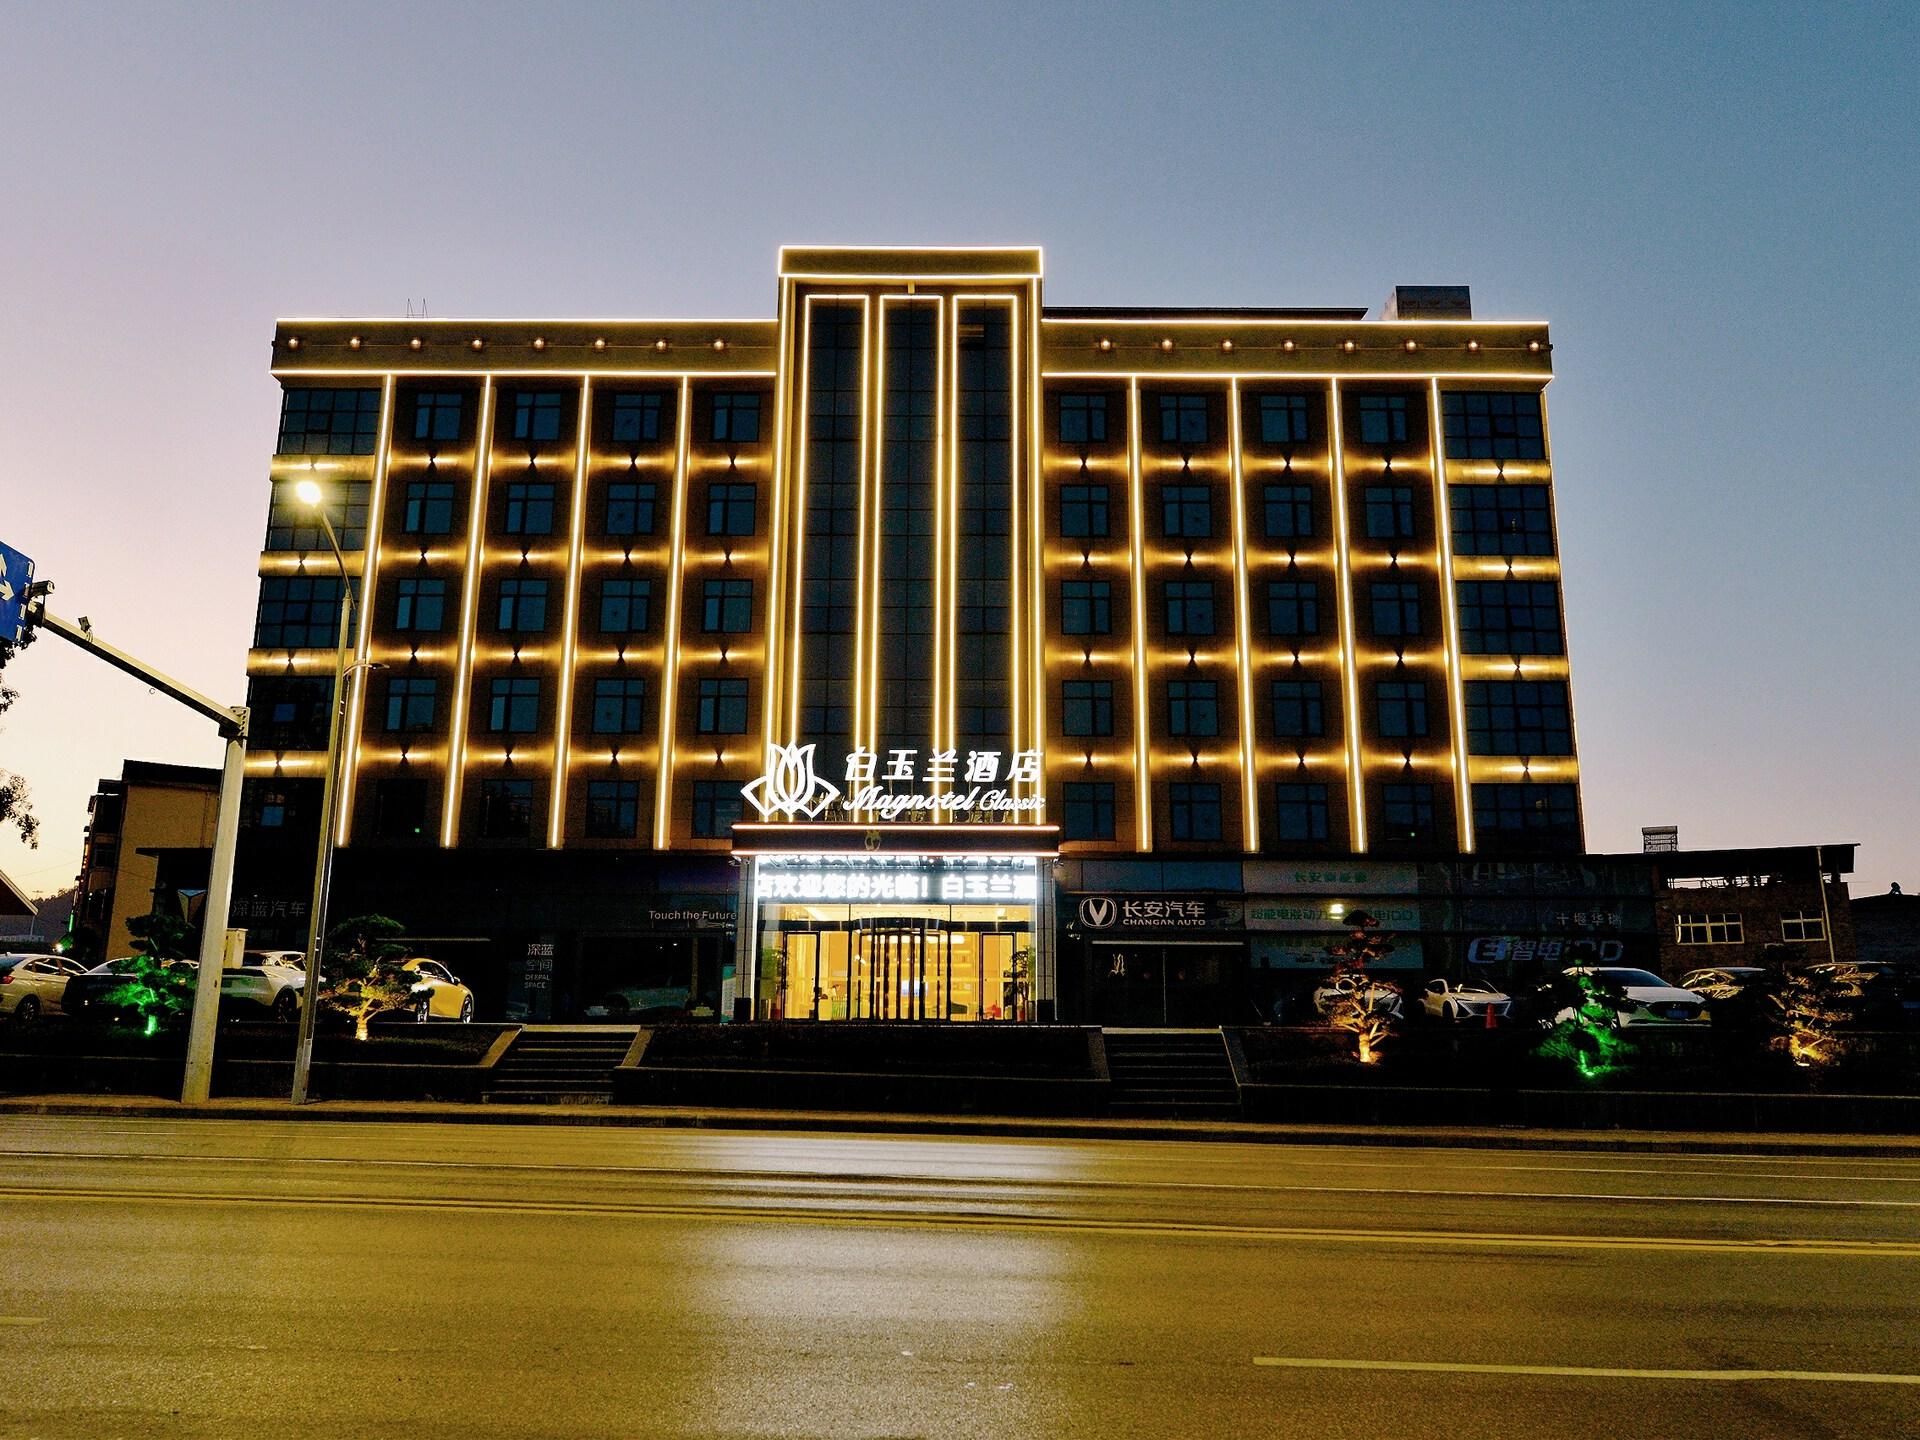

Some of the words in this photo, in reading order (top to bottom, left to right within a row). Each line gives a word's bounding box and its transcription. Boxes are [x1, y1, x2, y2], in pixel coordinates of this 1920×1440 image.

[844, 746, 1044, 783] 白玉兰酒店
[842, 786, 975, 820] Magnotel
[979, 789, 1046, 811] Classic
[648, 910, 681, 920] Touch
[682, 910, 700, 920] the
[702, 910, 737, 920] Future
[1122, 900, 1206, 918] 长安汽车
[1122, 918, 1175, 926] CHANGAN
[1177, 918, 1206, 926] AUTO
[527, 943, 555, 956] 深蓝
